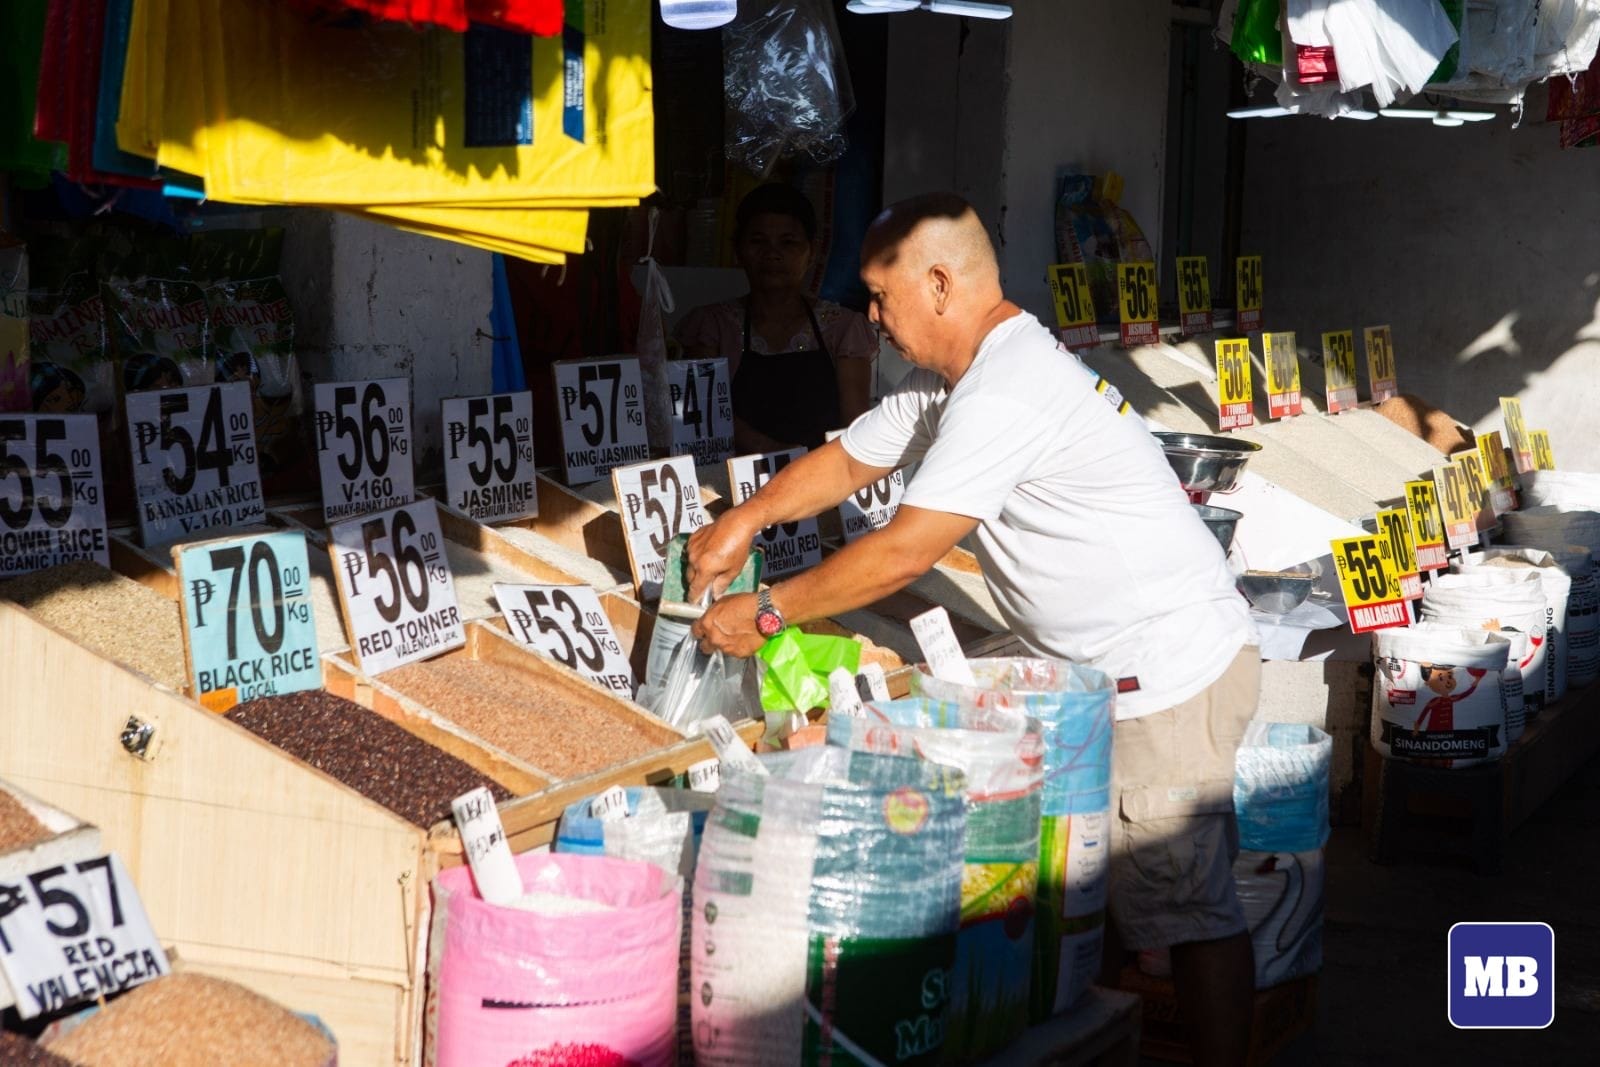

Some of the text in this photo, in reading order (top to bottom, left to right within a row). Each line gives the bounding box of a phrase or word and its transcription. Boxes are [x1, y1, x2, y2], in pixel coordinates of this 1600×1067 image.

[624, 384, 637, 399] 00
[229, 413, 248, 431] 00
[388, 407, 404, 424] 00
[627, 409, 642, 426] Kg
[719, 405, 731, 419] Kg
[516, 418, 529, 433] 00
[233, 445, 256, 465] Kg
[390, 436, 408, 456] Kg
[518, 444, 533, 462] Kg
[566, 444, 649, 468] KING JASMINE
[71, 449, 91, 468] 00
[74, 483, 98, 505] Kg
[342, 477, 393, 503] V-160
[458, 481, 533, 510] JASMINE
[683, 485, 696, 501] 00
[144, 487, 225, 522] BANSALAN
[227, 481, 260, 505] RICE
[469, 500, 526, 521] PREMIUM RICE
[689, 512, 704, 527] Kg
[0, 528, 105, 556] OWN RICE
[798, 533, 819, 554] RED
[343, 510, 436, 624] ₱56 00
[428, 563, 447, 584] Kg
[767, 554, 804, 573] PREMIUM
[1386, 574, 1401, 598] Kg
[190, 540, 300, 660] ₱70 00
[288, 601, 309, 623] Kg
[586, 612, 603, 627] 00
[1353, 603, 1405, 629] MALAGKIT
[360, 606, 460, 658] RED TONNER
[395, 632, 440, 659] VALENCIA
[599, 637, 620, 655] Kg
[199, 647, 314, 695] BLACK RICE
[242, 680, 278, 703] LOCAL
[1395, 738, 1486, 751] SINANDOMENG
[62, 937, 116, 966] RED
[27, 949, 162, 1012] VALENCIA
